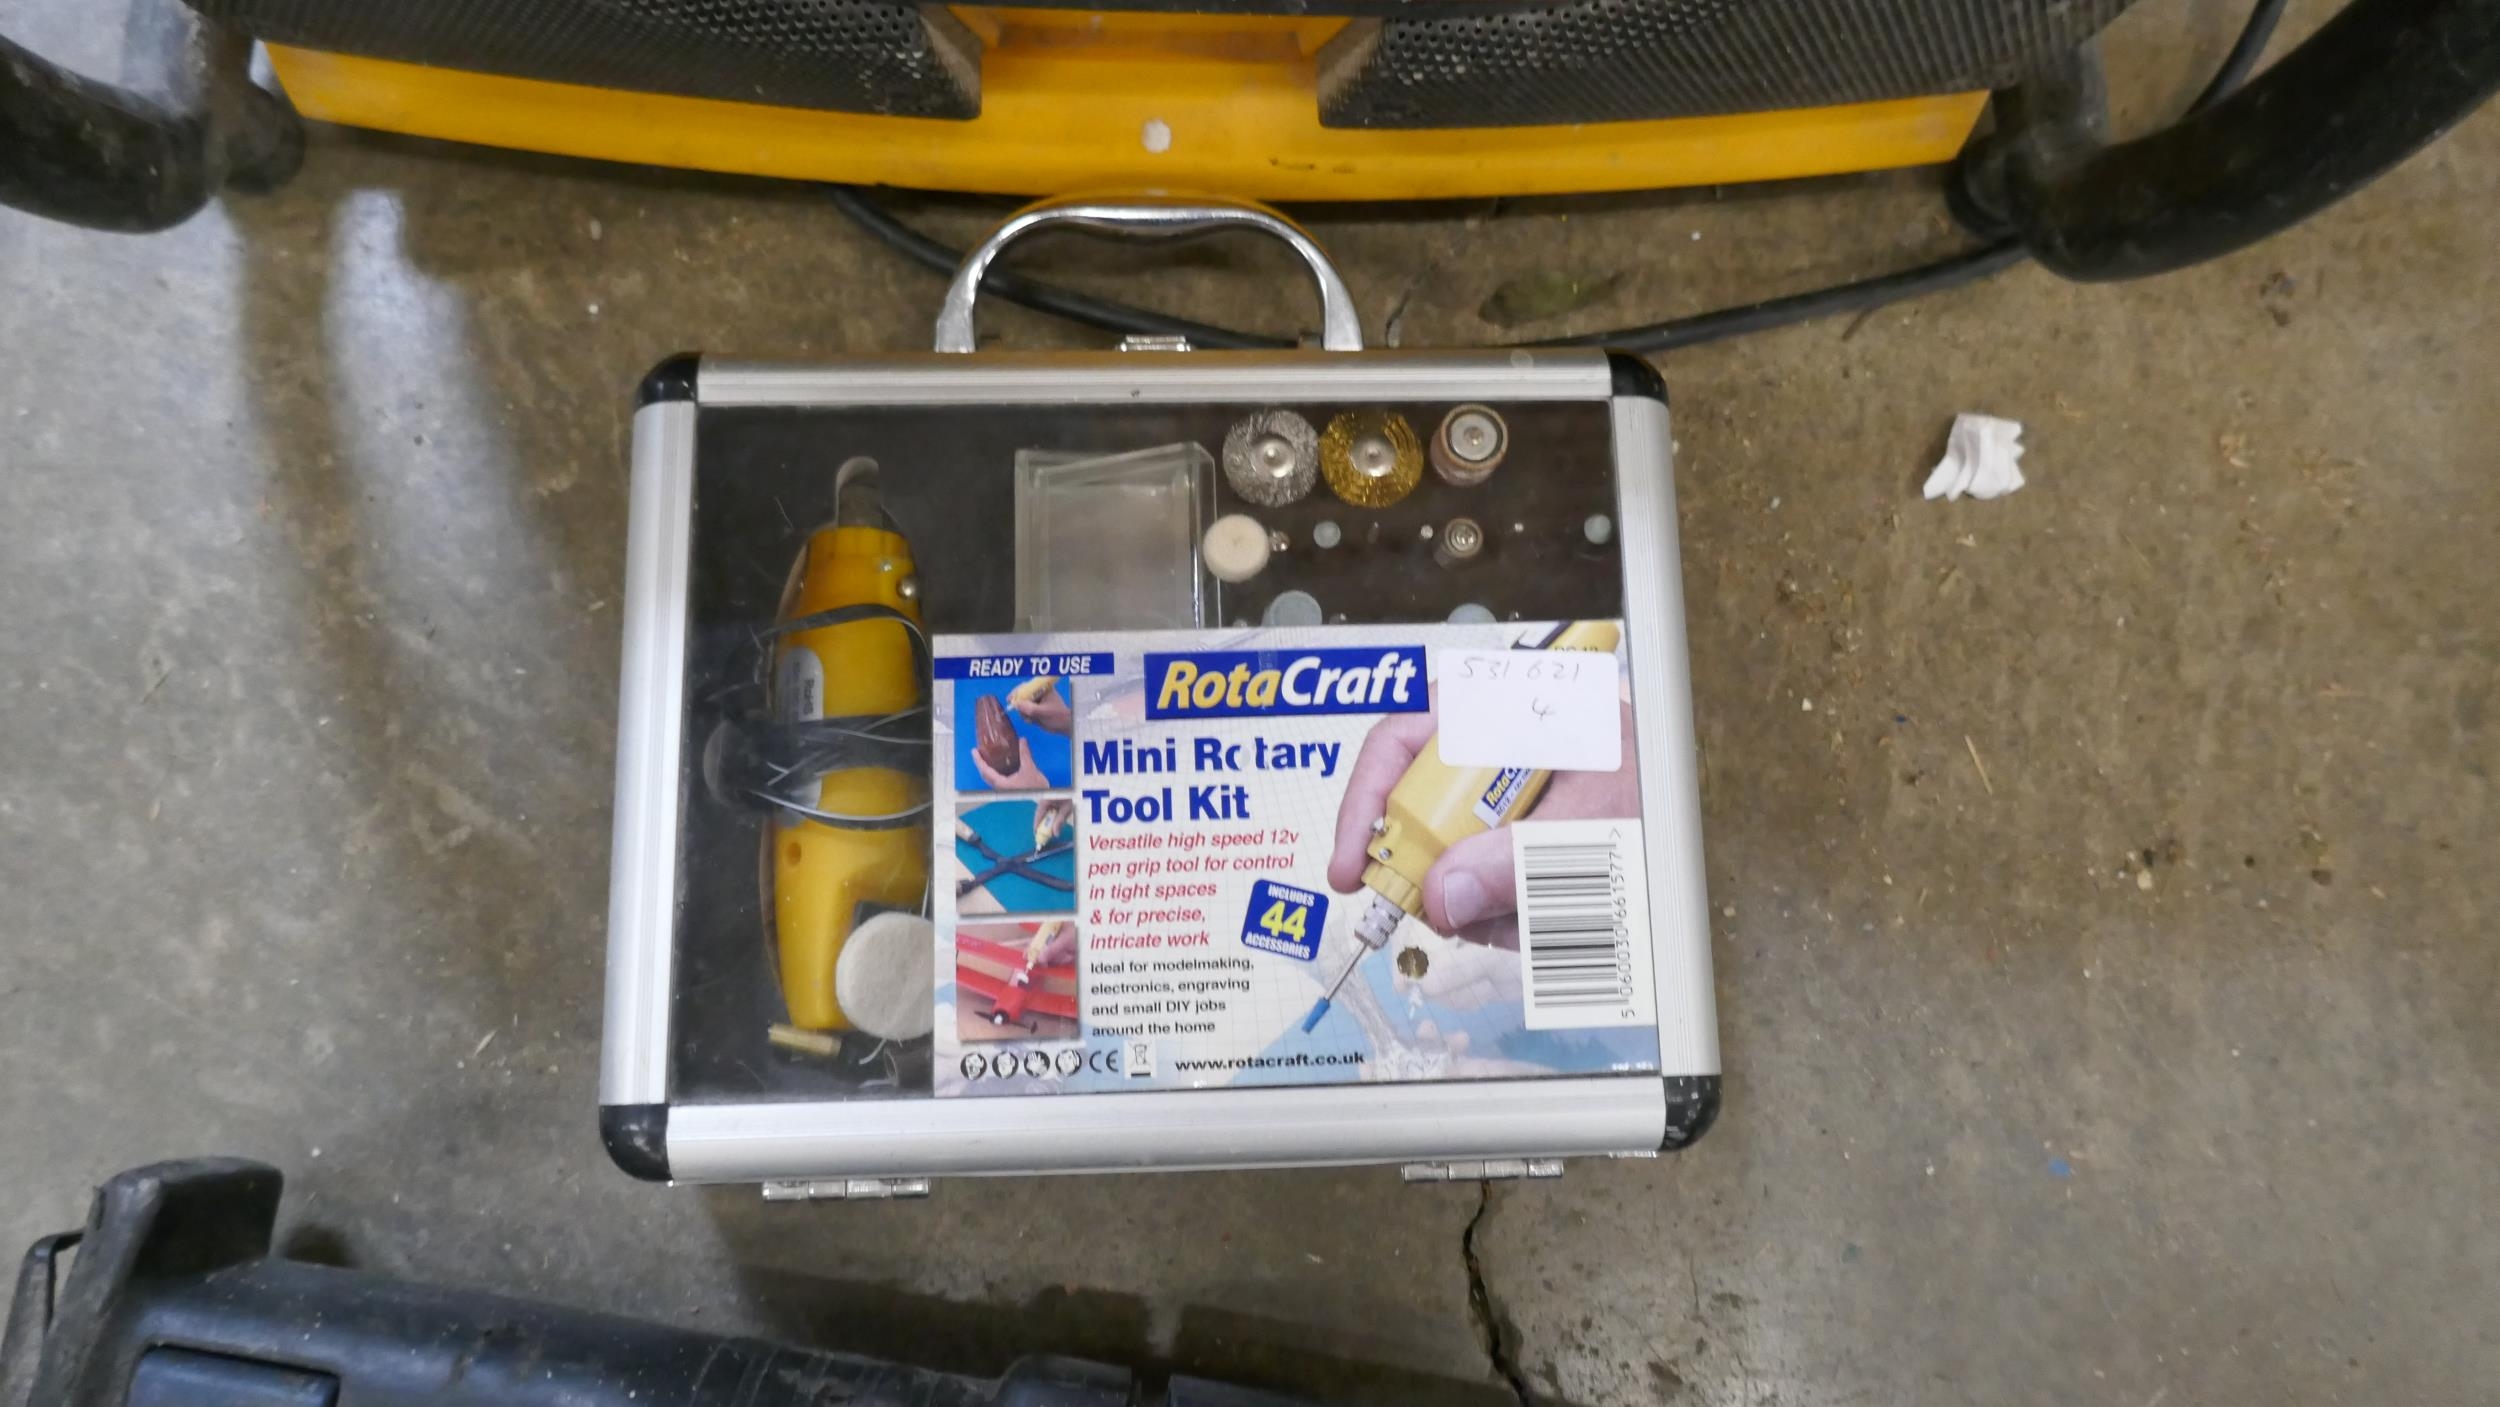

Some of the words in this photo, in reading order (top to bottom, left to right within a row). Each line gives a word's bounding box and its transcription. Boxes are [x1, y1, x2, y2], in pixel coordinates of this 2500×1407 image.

[969, 658, 1023, 677] READY
[1030, 657, 1049, 675] TO
[1059, 655, 1091, 674] USE
[1460, 656, 1510, 679] 531
[1525, 658, 1580, 681] 621
[1157, 652, 1416, 708] RotaCraft
[1083, 738, 1176, 774] Mini
[1082, 788, 1172, 824] Tool
[1189, 785, 1250, 820] Kit
[1089, 833, 1163, 850] Versatile
[1168, 832, 1205, 851] high
[1211, 830, 1264, 848] speed
[1270, 829, 1299, 845] 12v
[1088, 860, 1121, 878] pen
[1126, 857, 1161, 878] grip
[1166, 857, 1200, 873] tool
[1204, 856, 1228, 872] for
[1233, 854, 1294, 871] control
[1089, 885, 1105, 899] in
[1110, 883, 1150, 902] tight
[1155, 882, 1217, 899] spaces
[1267, 884, 1315, 905] INCLUDES
[1090, 910, 1102, 925] &
[1108, 909, 1132, 924] for
[1137, 908, 1206, 925] precise,
[1260, 901, 1308, 942] 44
[1090, 932, 1162, 950] intricate
[1167, 931, 1210, 947] work
[1244, 932, 1311, 960] ACCESSORIES
[1091, 963, 1124, 974] Ideal
[1130, 961, 1149, 973] for
[1153, 957, 1255, 973] modelmaking,
[1091, 983, 1174, 997] electronics,
[1178, 979, 1250, 995] engraving
[1091, 1004, 1118, 1016] and
[1123, 1001, 1162, 1014] small
[1166, 1001, 1191, 1013] DIY
[1194, 1000, 1226, 1015] jobs
[1092, 1025, 1142, 1038] around
[1148, 1024, 1172, 1035] the
[1175, 1022, 1216, 1034] home
[1089, 1050, 1120, 1074] CE
[1175, 1052, 1365, 1073] www.rotacraft.co.uk
